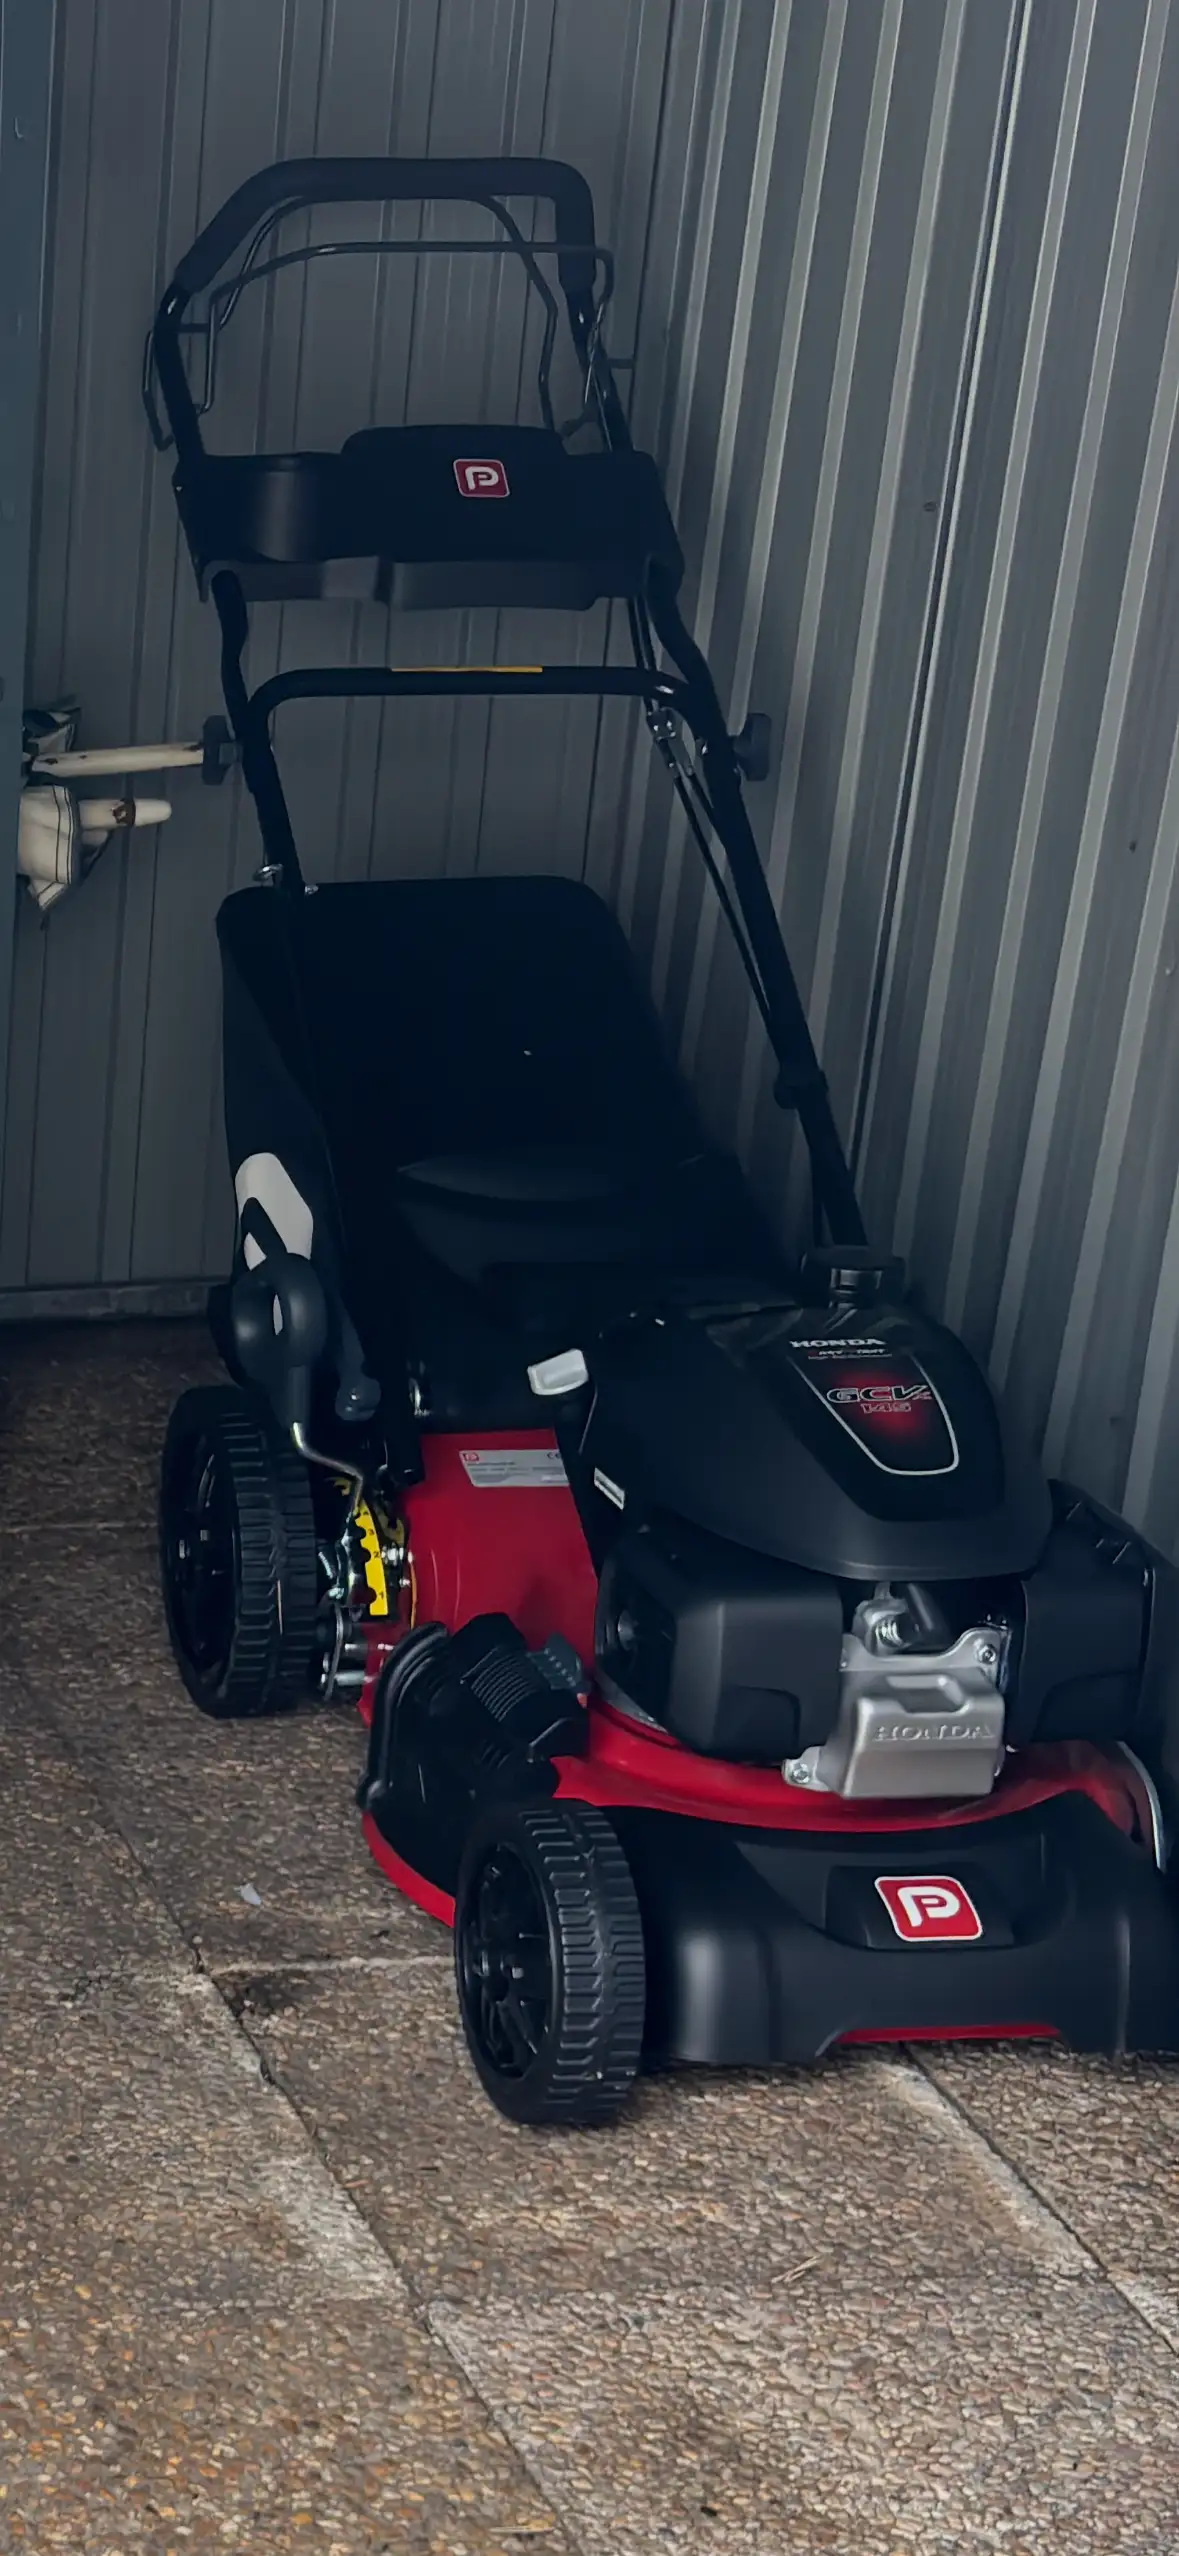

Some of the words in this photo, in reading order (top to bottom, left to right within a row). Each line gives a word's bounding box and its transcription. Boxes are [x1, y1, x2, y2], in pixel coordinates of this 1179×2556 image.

[790, 1339, 887, 1348] HONDA
[860, 1402, 912, 1414] 145
[874, 1724, 997, 1742] HONDA
